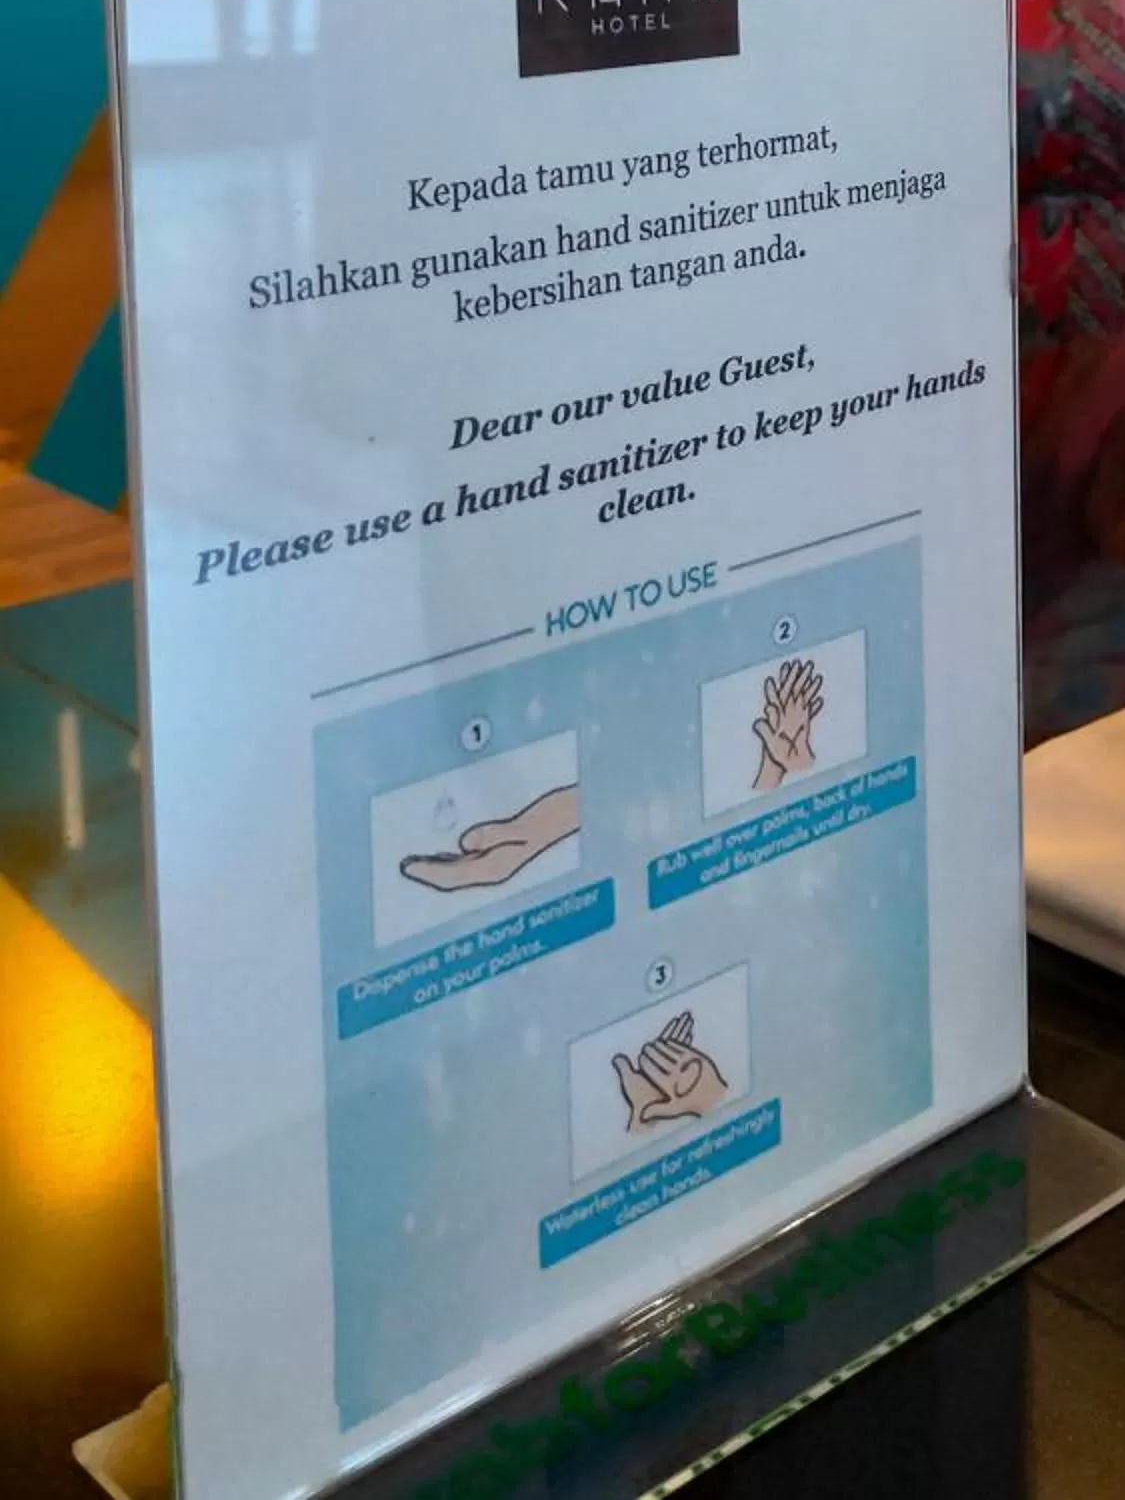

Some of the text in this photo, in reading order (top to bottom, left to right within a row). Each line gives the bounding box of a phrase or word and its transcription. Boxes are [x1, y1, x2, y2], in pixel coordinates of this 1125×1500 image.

[591, 13, 672, 36] HOTEL
[408, 126, 838, 212] Kepada tamu yang terhormat,
[249, 169, 946, 308] Silahkan gunakan hand sanitizer untuk menjaga
[454, 233, 806, 322] kebersihan tangan anda.
[448, 343, 815, 450] Dear our value Guest,
[192, 358, 987, 586] Please use a hand sanitizer to keep your hands
[598, 483, 696, 523] clean.
[545, 561, 718, 637] HOW TO USE
[778, 621, 791, 639] 2
[471, 724, 482, 742] 1
[656, 851, 688, 878] Rub
[691, 832, 723, 861] well
[725, 820, 760, 848] over
[849, 778, 867, 798] of
[867, 762, 909, 790] hands
[700, 859, 731, 883] and
[733, 821, 809, 868] fingernails
[813, 809, 845, 835] until
[443, 938, 475, 965] the
[477, 915, 526, 949] hand
[529, 888, 601, 928] sanitizer
[413, 982, 440, 1004] on
[442, 960, 486, 995] your
[655, 964, 667, 986] 3
[614, 1194, 660, 1227] clean
[628, 1170, 659, 1194] use
[661, 1155, 684, 1177] for
